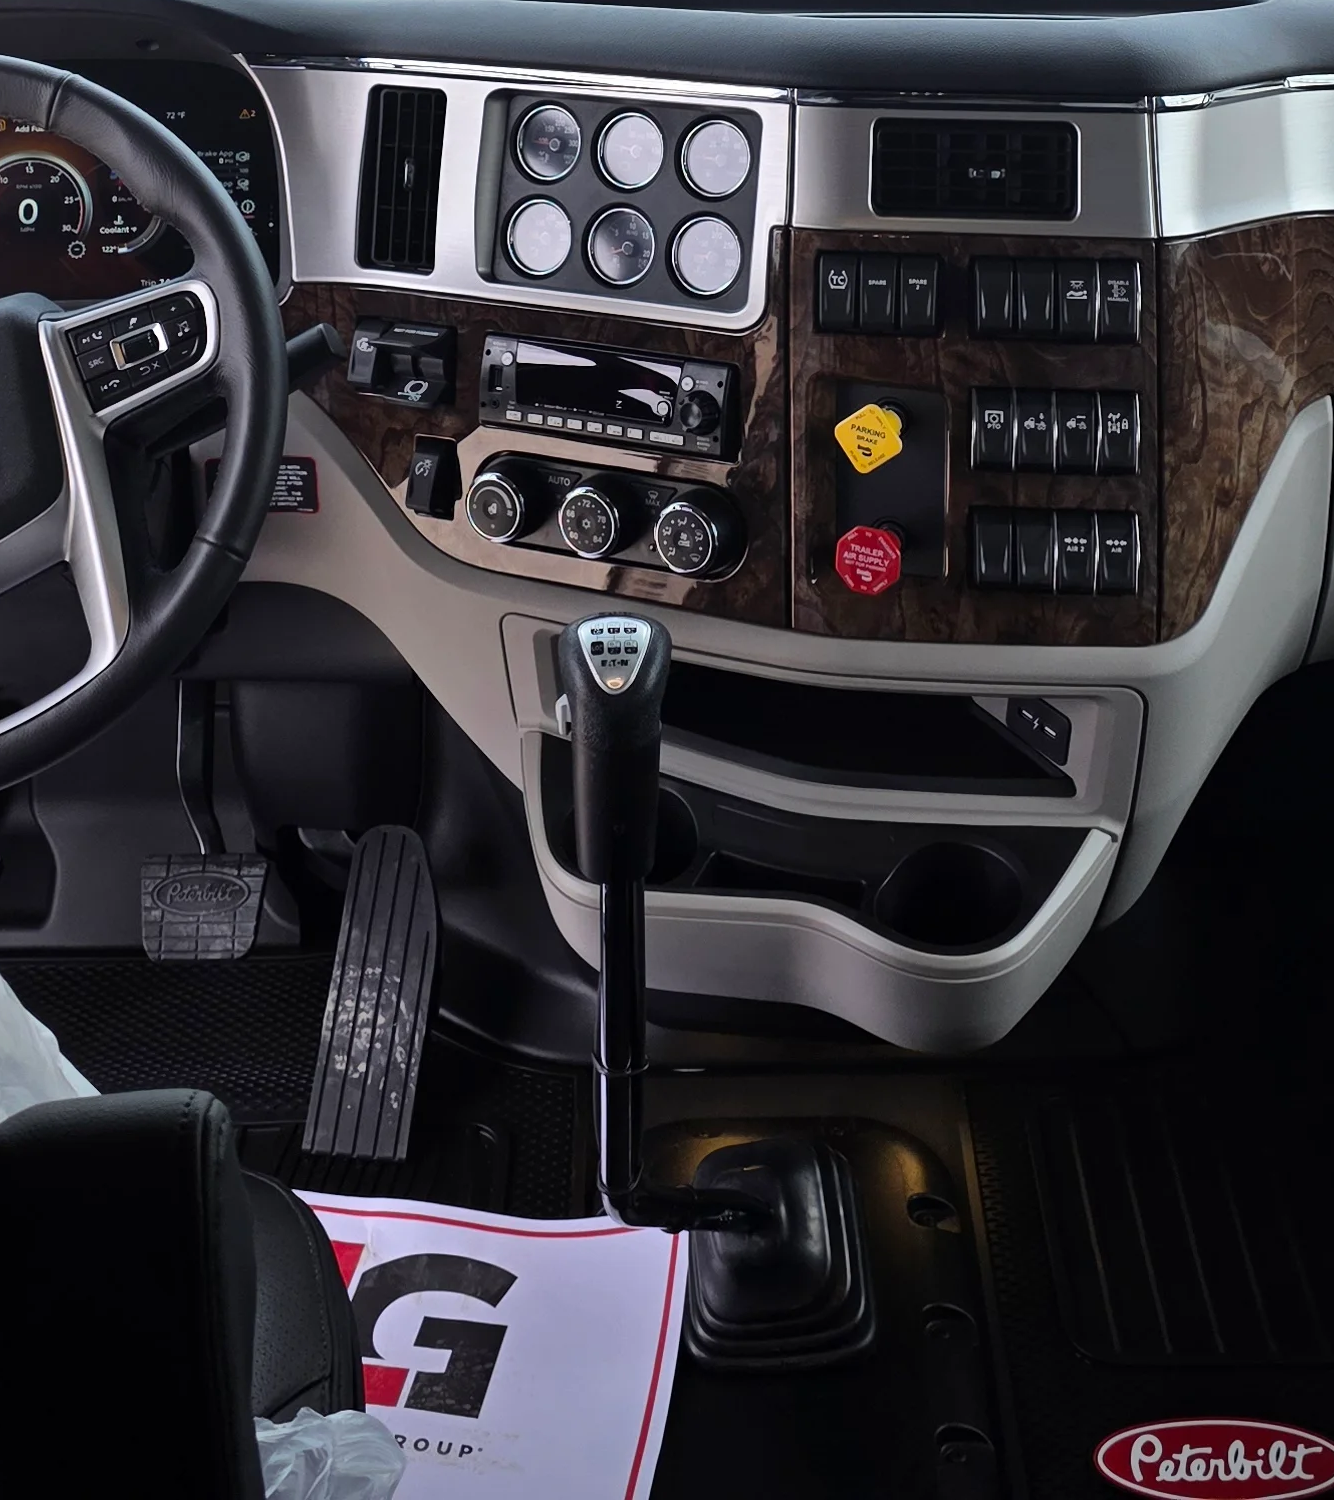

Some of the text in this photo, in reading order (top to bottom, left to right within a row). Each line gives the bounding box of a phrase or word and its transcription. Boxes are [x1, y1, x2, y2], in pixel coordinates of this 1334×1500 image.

[18, 198, 39, 225] 0
[62, 224, 72, 232] 30
[99, 226, 130, 234] Coolant
[831, 275, 845, 285] TC
[87, 357, 105, 369] SRC
[850, 423, 886, 439] PARKING
[856, 434, 878, 445] BRAKE
[548, 475, 571, 487] AUTO
[581, 499, 592, 509] 72
[850, 543, 884, 558] TRAILER
[843, 550, 890, 567] AIR SUPPLY
[1130, 1433, 1324, 1482] Peterbilt
